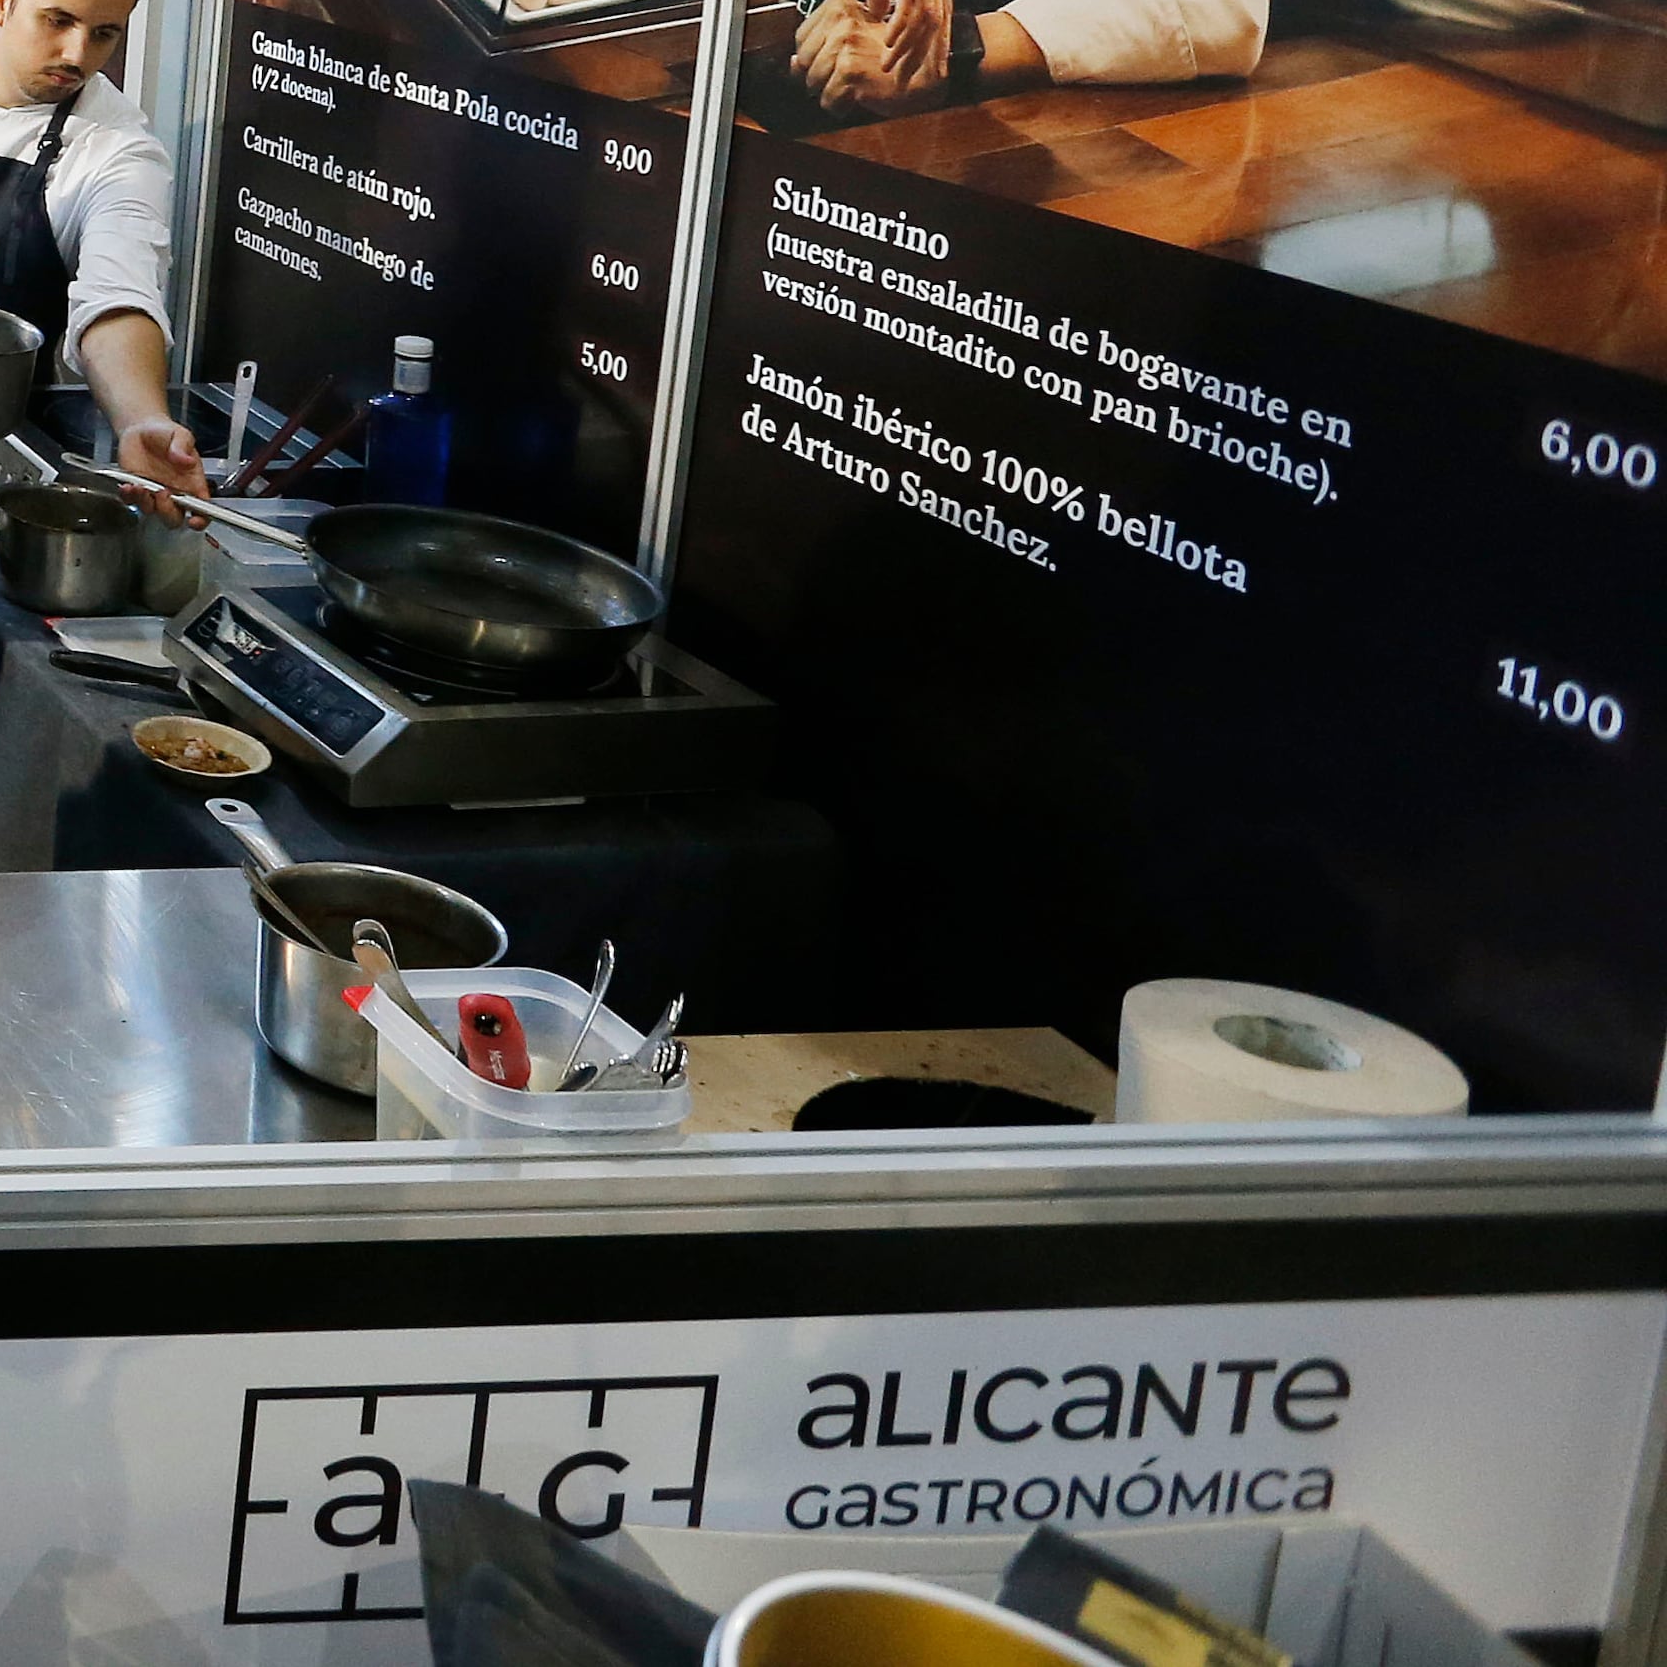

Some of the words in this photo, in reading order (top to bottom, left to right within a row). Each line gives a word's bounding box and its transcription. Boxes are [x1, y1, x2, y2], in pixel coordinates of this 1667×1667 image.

[251, 63, 280, 92] (1/2
[281, 74, 337, 114] docena).
[252, 31, 305, 68] Gamba
[309, 46, 365, 87] blanca
[368, 63, 392, 93] de
[394, 72, 450, 113] Santa
[454, 89, 500, 128] Pola
[504, 107, 579, 151] cocida
[243, 126, 319, 172] Carrillera
[322, 155, 344, 184] de
[347, 165, 390, 202] atún
[392, 183, 437, 223] rojo.
[603, 138, 653, 176] 9,00
[234, 225, 323, 283] camarones.
[238, 188, 313, 239] Gazpacho
[315, 221, 406, 282] manchego
[410, 259, 435, 292] de
[771, 176, 951, 262] Submarino
[590, 254, 640, 292] 6,00
[580, 342, 629, 383] 5,00
[765, 222, 875, 284] (nuestra
[880, 262, 1042, 342] ensaladilla
[1047, 314, 1090, 355] de
[1097, 330, 1290, 426] bogavante
[1299, 402, 1354, 450] en
[760, 269, 858, 324] versión
[862, 304, 1016, 381] montadito
[1022, 362, 1084, 405] con
[1088, 387, 1159, 439] pan
[1166, 407, 1340, 506] brioche).
[740, 403, 779, 447] de
[782, 423, 892, 497] Arturo
[897, 469, 1059, 575] Sanchez.
[745, 353, 846, 423] Jamón
[852, 387, 973, 475] ibérico
[980, 448, 1087, 525] 100%
[1096, 493, 1250, 595] bellota
[1539, 416, 1659, 492] 6,00
[1494, 655, 1626, 742] 11,00
